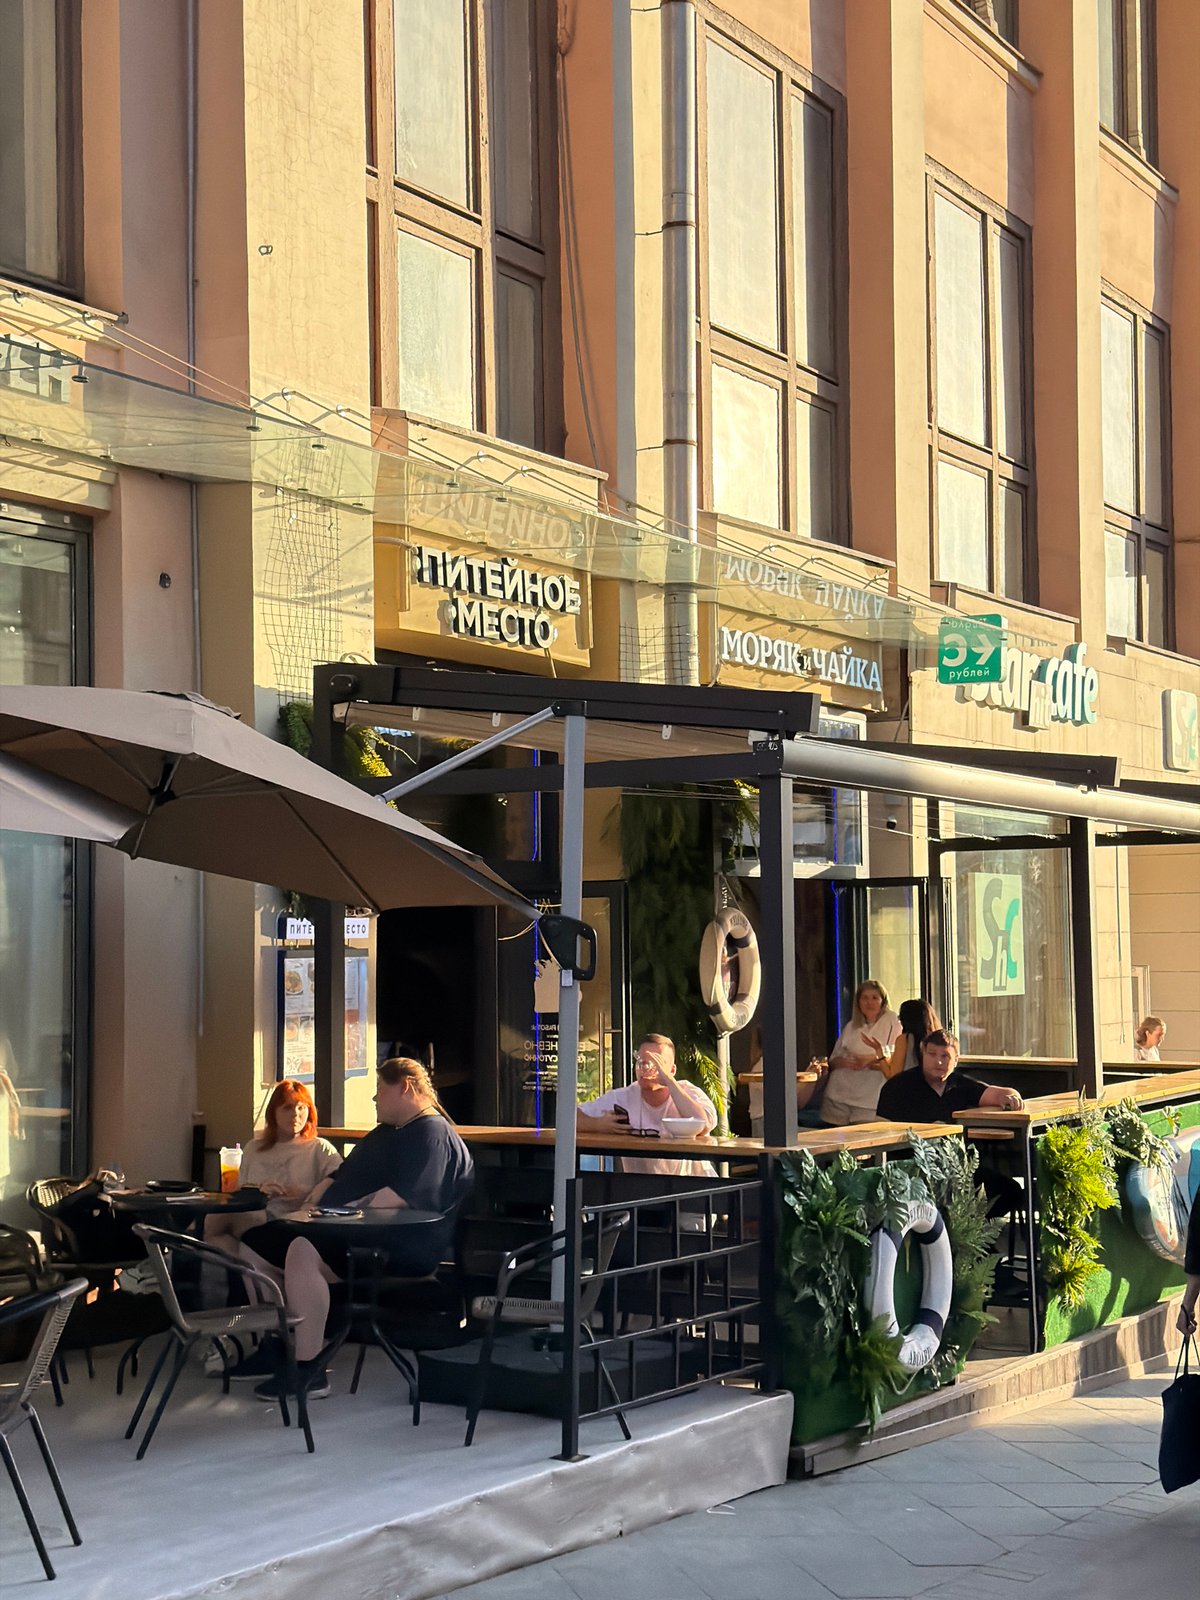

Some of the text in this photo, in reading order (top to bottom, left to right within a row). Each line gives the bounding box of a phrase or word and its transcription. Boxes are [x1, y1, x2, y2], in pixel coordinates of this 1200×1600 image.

[419, 545, 581, 615] ПИТЕЙНОЕ
[456, 596, 554, 649] МЕСТО
[720, 626, 806, 678] МОРЯК
[812, 646, 882, 692] ЧАЙКА
[949, 666, 990, 681] рублей
[1045, 641, 1099, 725] cafe
[289, 923, 367, 935] ПИТЕ ЕСТО
